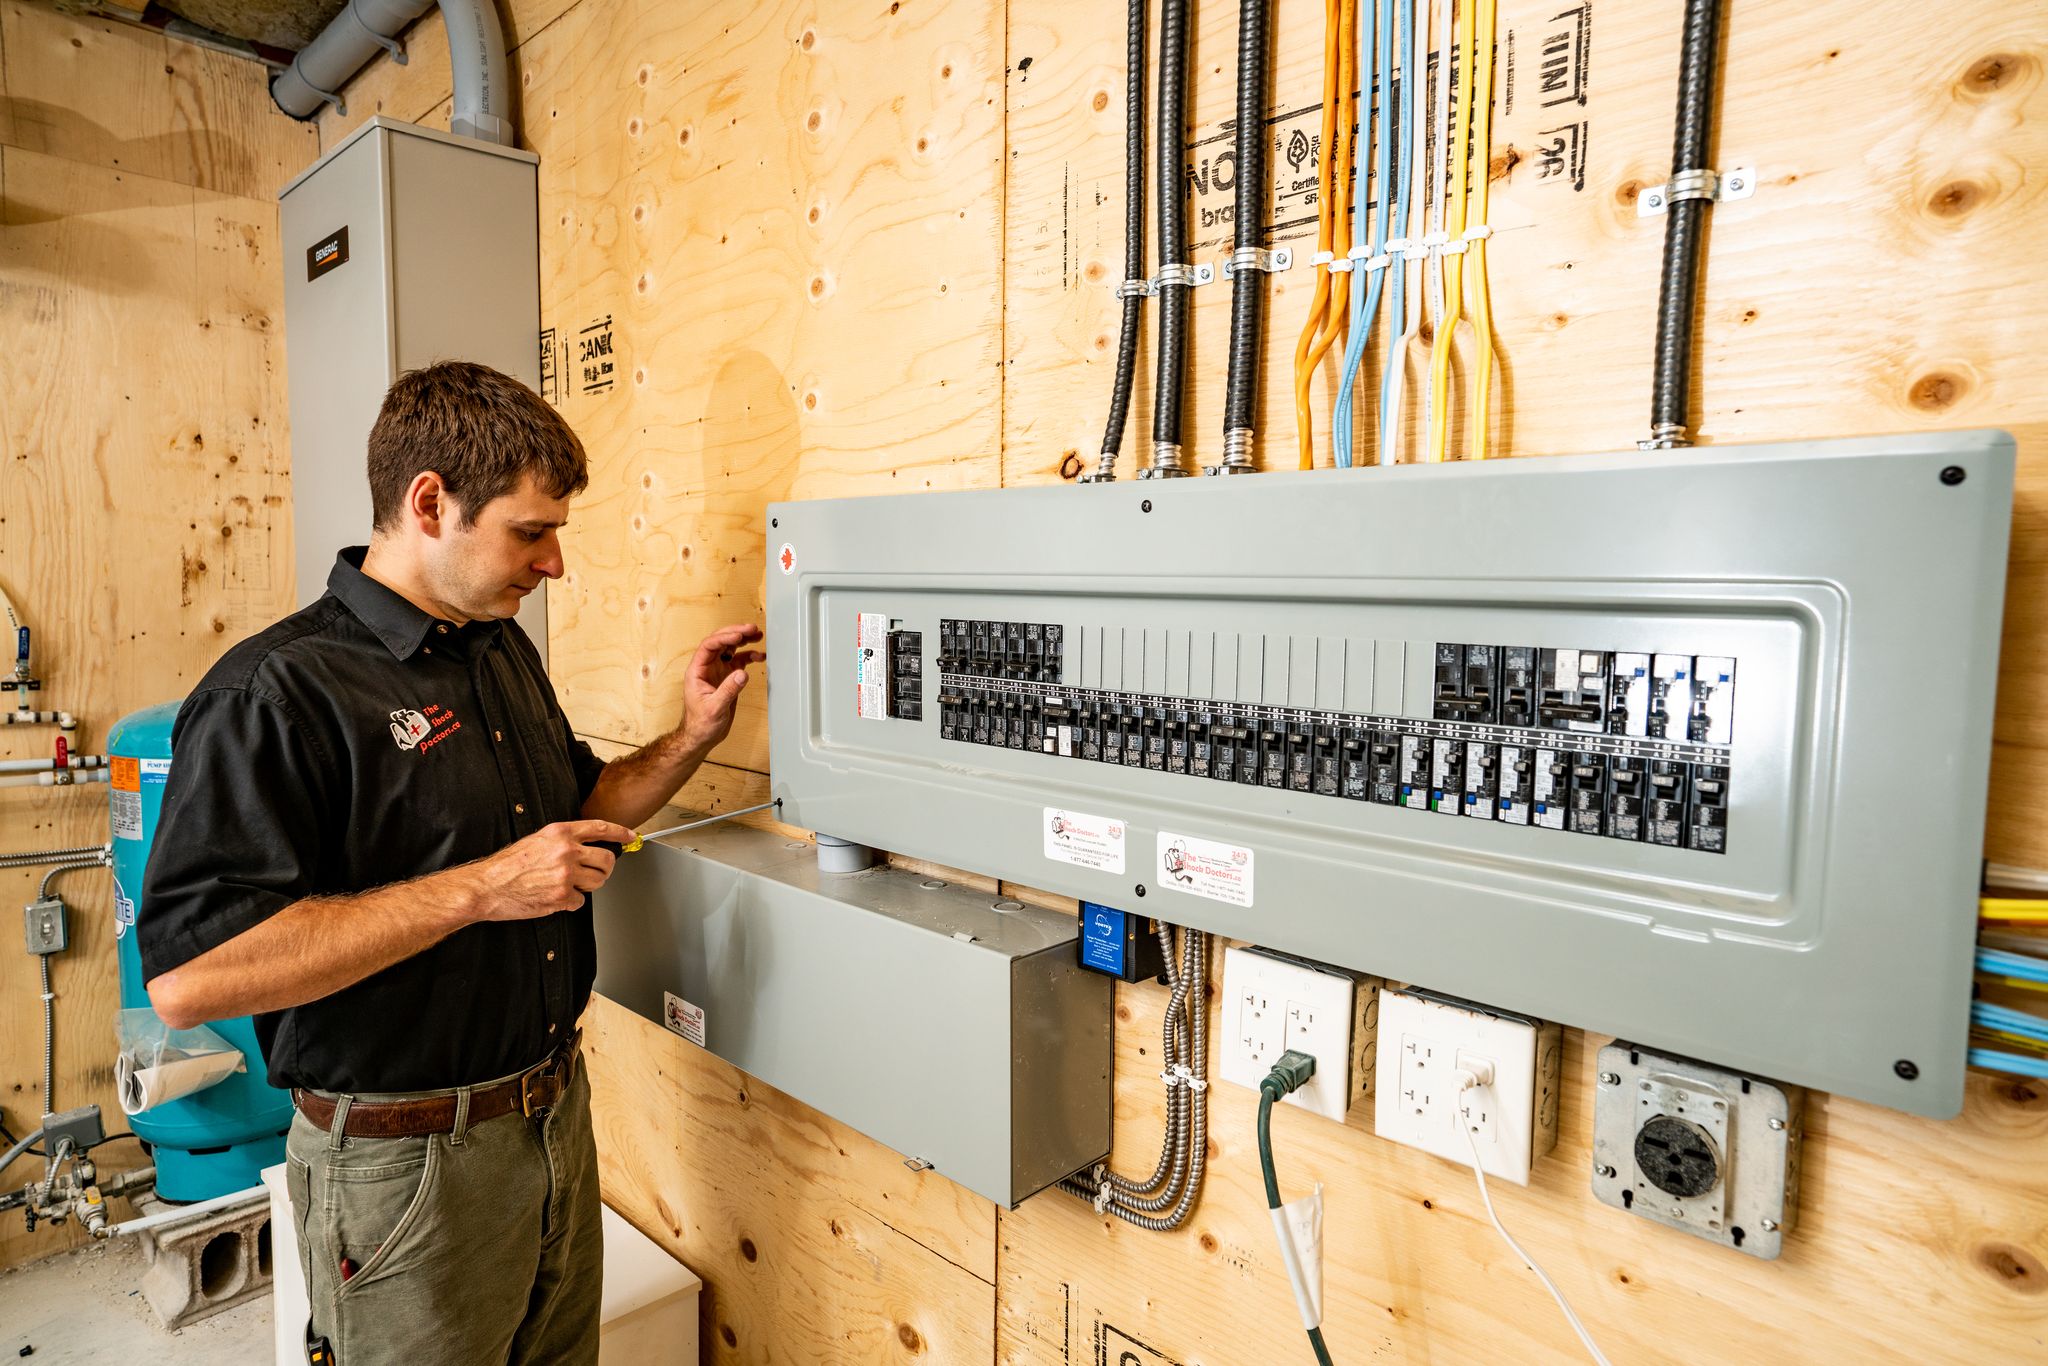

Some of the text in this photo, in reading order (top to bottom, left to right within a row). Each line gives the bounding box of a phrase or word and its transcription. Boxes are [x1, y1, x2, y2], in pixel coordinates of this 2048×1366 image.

[316, 240, 338, 262] GENERAC
[422, 704, 439, 716] The
[431, 709, 454, 727] Shock
[420, 721, 461, 754] Doctors.ca
[1184, 851, 1197, 862] The
